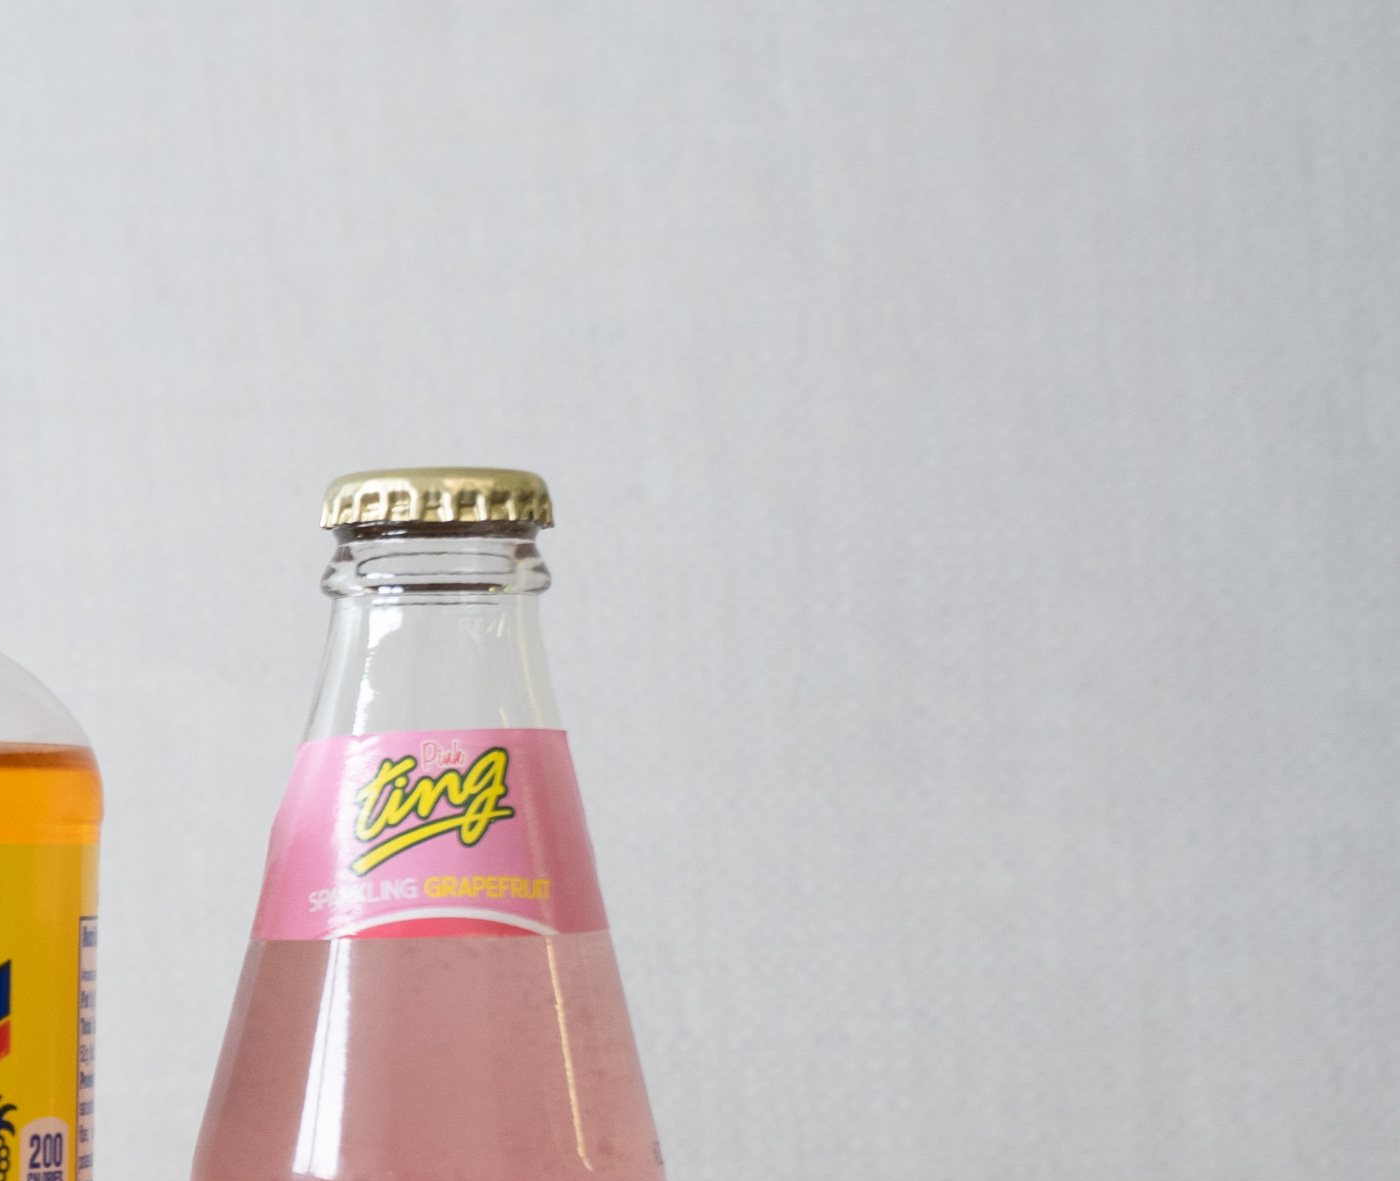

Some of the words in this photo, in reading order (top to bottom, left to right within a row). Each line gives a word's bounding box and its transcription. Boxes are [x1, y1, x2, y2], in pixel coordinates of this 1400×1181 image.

[354, 746, 515, 848] ting
[423, 876, 550, 900] GRAPEFRUIT
[28, 1131, 64, 1170] 200
